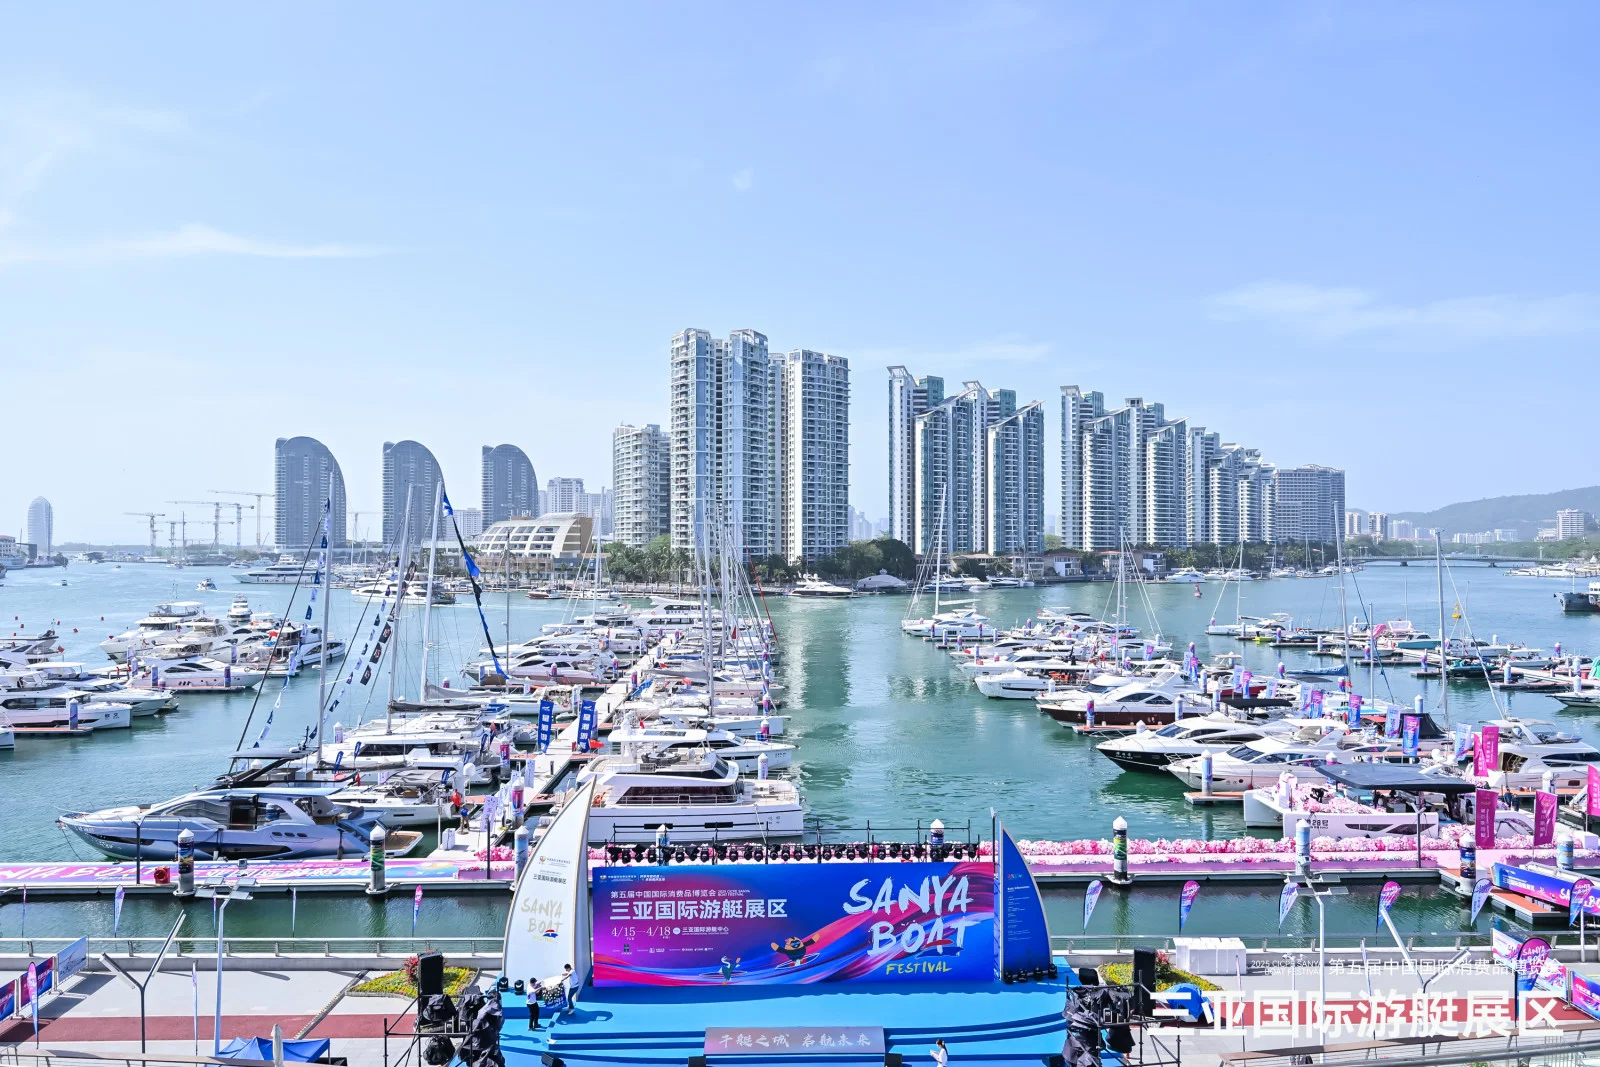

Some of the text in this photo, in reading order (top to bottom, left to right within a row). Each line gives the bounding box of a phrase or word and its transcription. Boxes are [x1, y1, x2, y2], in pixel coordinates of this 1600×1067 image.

[610, 889, 717, 899] 第五届中国国际消费品博览会
[843, 874, 975, 916] SANYA
[520, 897, 563, 918] SANYA
[609, 898, 788, 921] 三亚国际游艇展区
[527, 917, 564, 934] BOAT
[866, 915, 981, 957] BOAT
[885, 961, 953, 975] FESTIVAL
[719, 1032, 872, 1048] 千艇之城 启航未来
